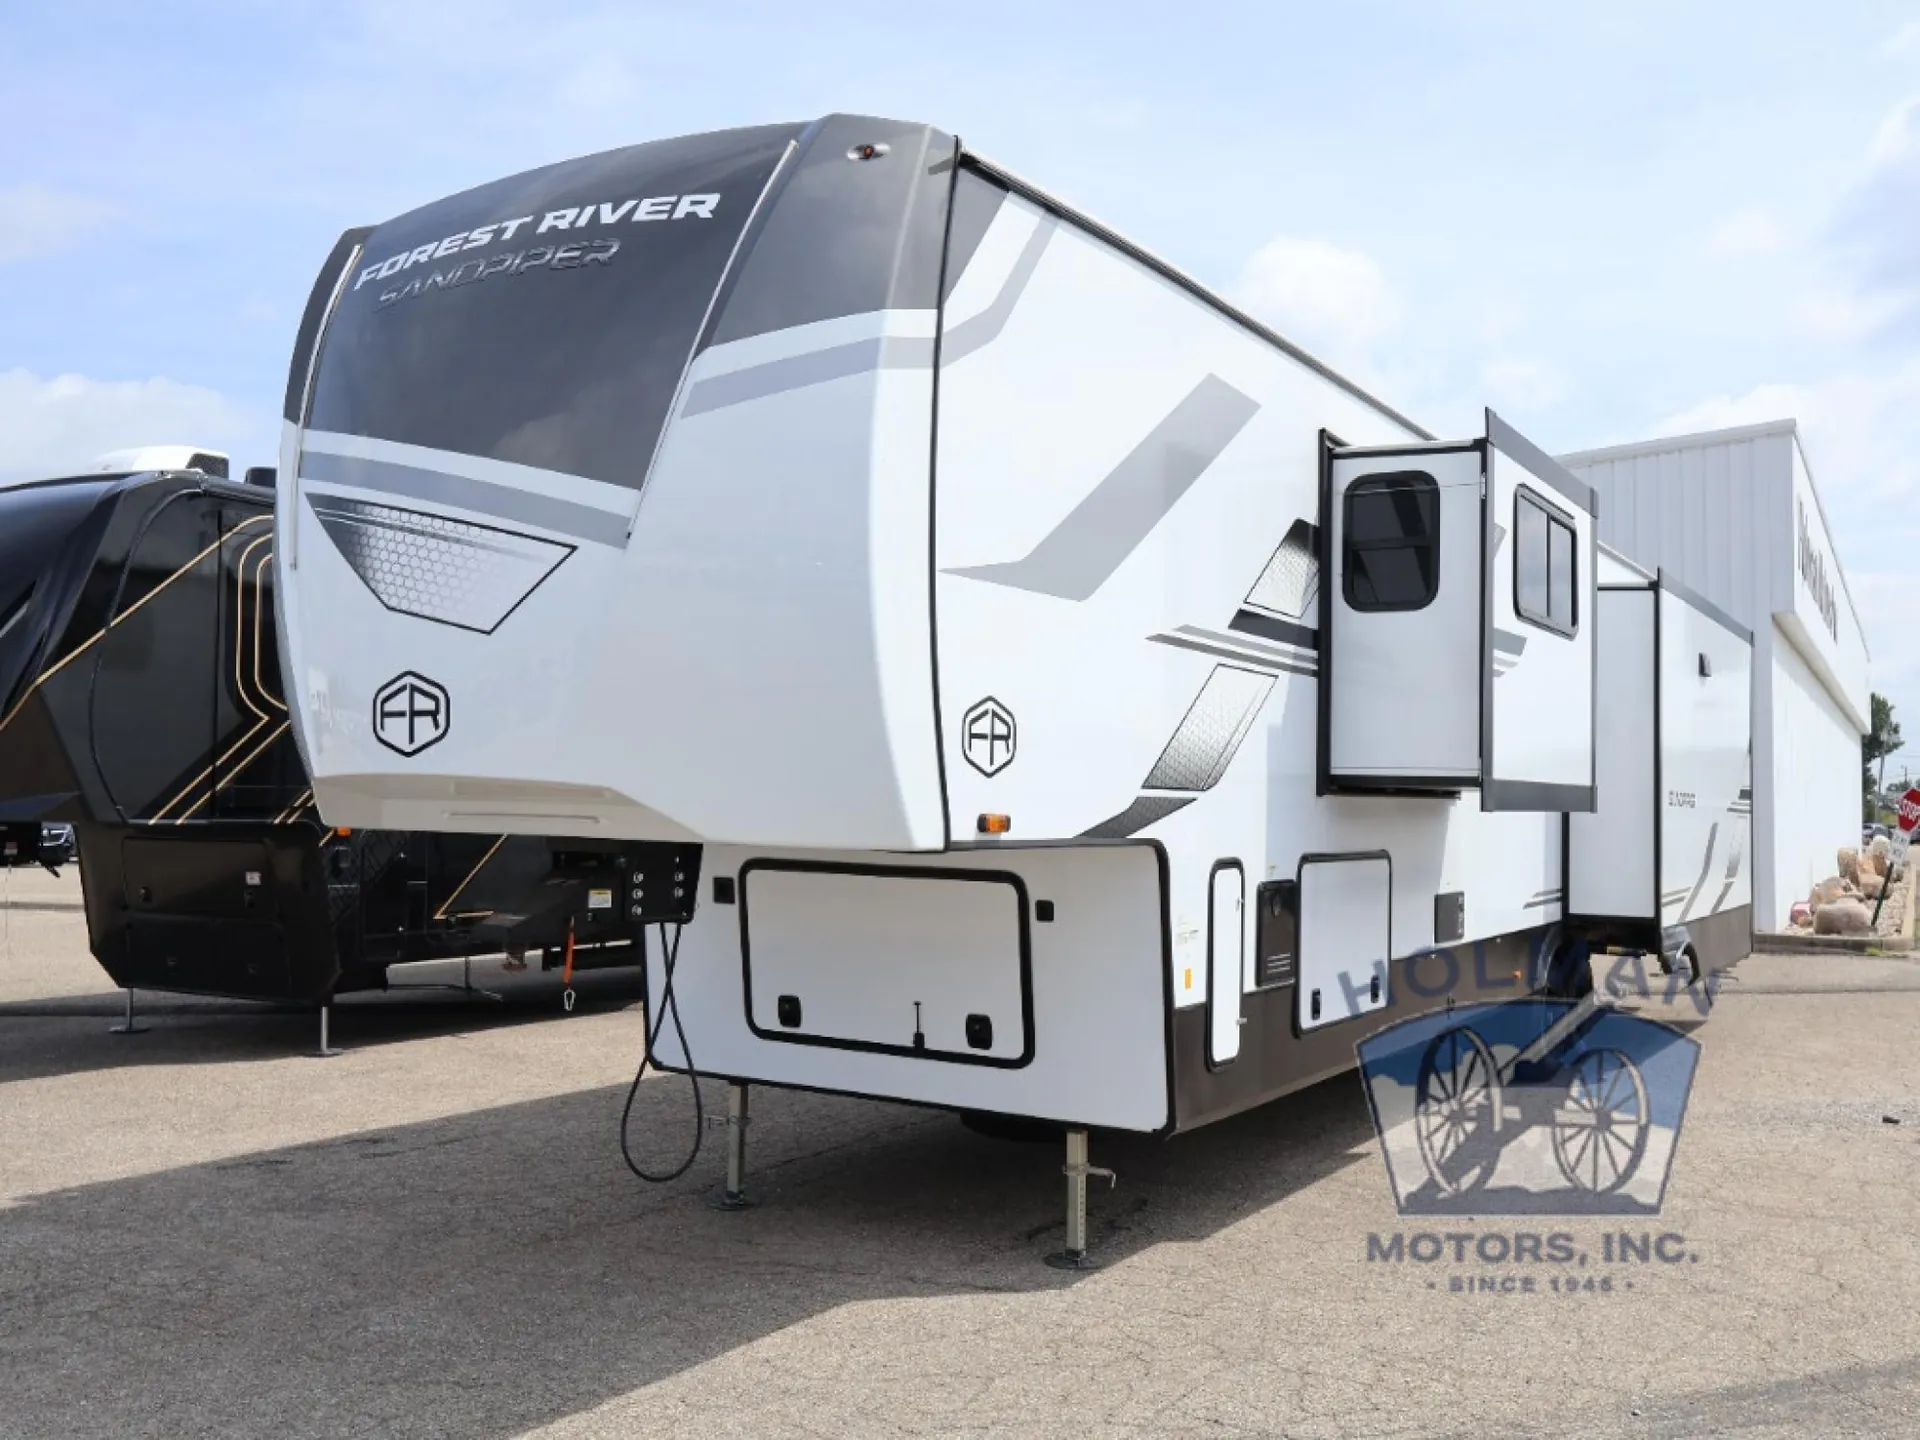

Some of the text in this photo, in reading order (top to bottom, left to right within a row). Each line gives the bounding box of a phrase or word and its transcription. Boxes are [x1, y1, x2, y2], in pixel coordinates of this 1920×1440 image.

[354, 193, 721, 291] FOREST RIVER
[375, 238, 621, 311] SANDPIPER
